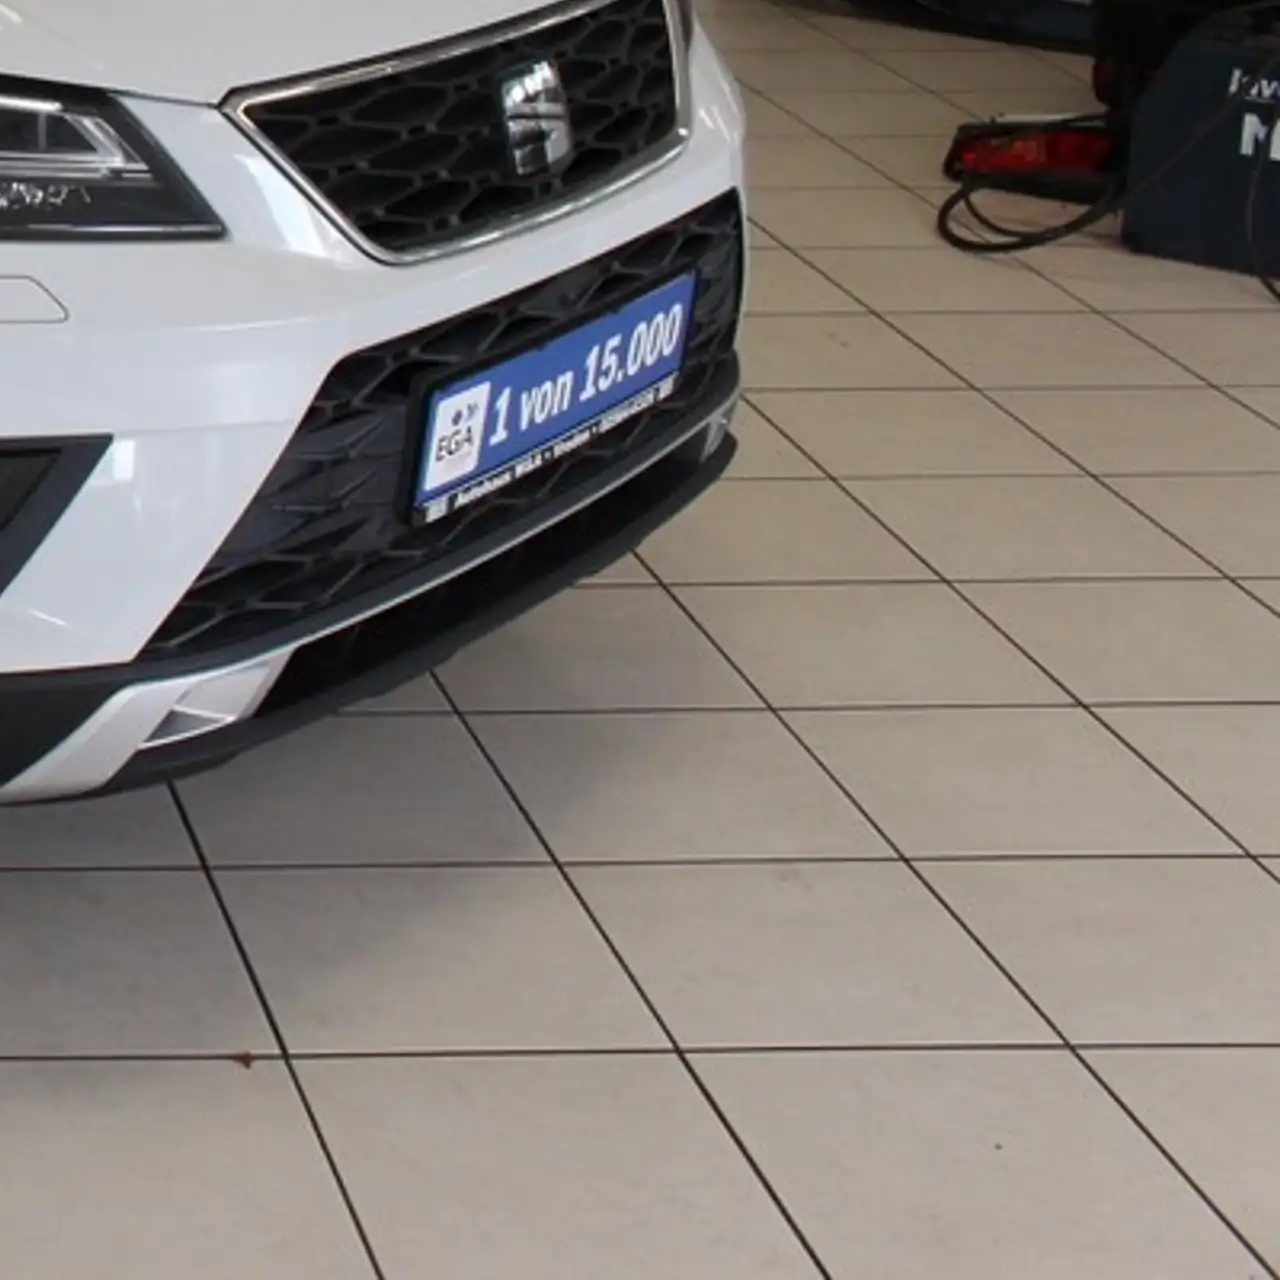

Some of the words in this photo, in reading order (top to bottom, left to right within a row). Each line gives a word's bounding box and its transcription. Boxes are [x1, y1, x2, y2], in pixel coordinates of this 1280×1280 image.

[488, 385, 513, 446] 1
[519, 370, 575, 431] von
[579, 302, 684, 403] 15.000
[434, 426, 474, 462] EGA
